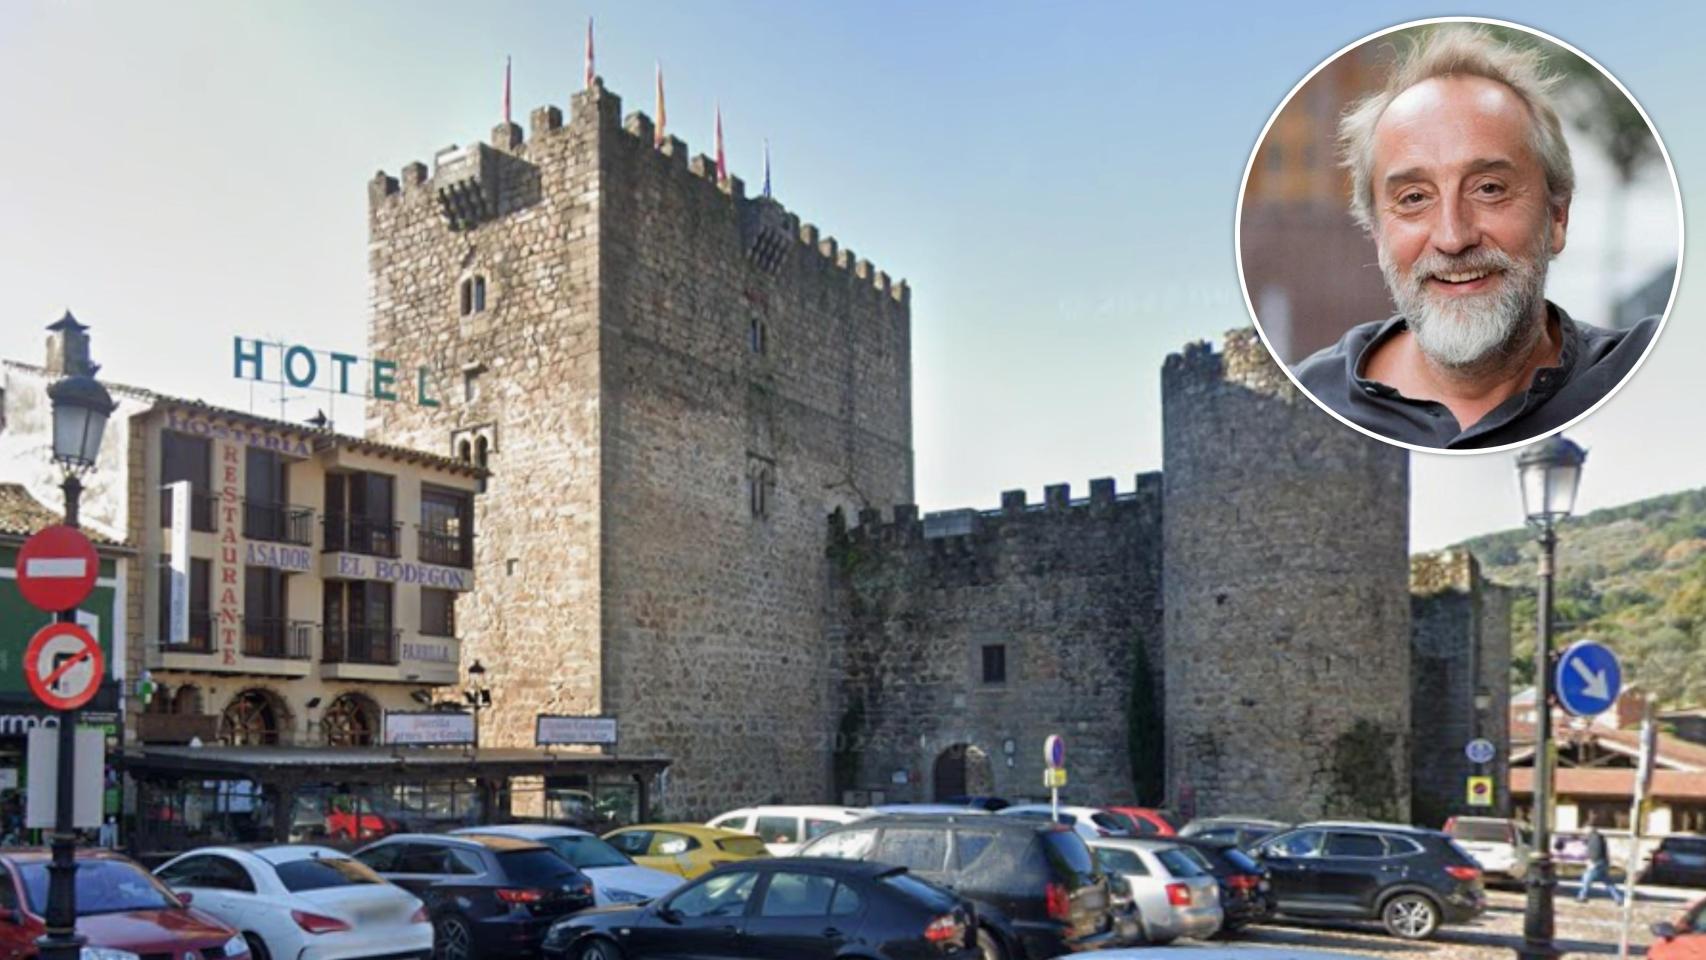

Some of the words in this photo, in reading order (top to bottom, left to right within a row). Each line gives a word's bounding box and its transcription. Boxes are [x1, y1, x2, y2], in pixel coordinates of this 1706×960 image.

[233, 336, 439, 407] HOTEL
[219, 445, 239, 666] RESTAURANTE
[247, 543, 311, 570] ASADOR
[338, 555, 365, 577] EL
[375, 560, 466, 589] BODEGON
